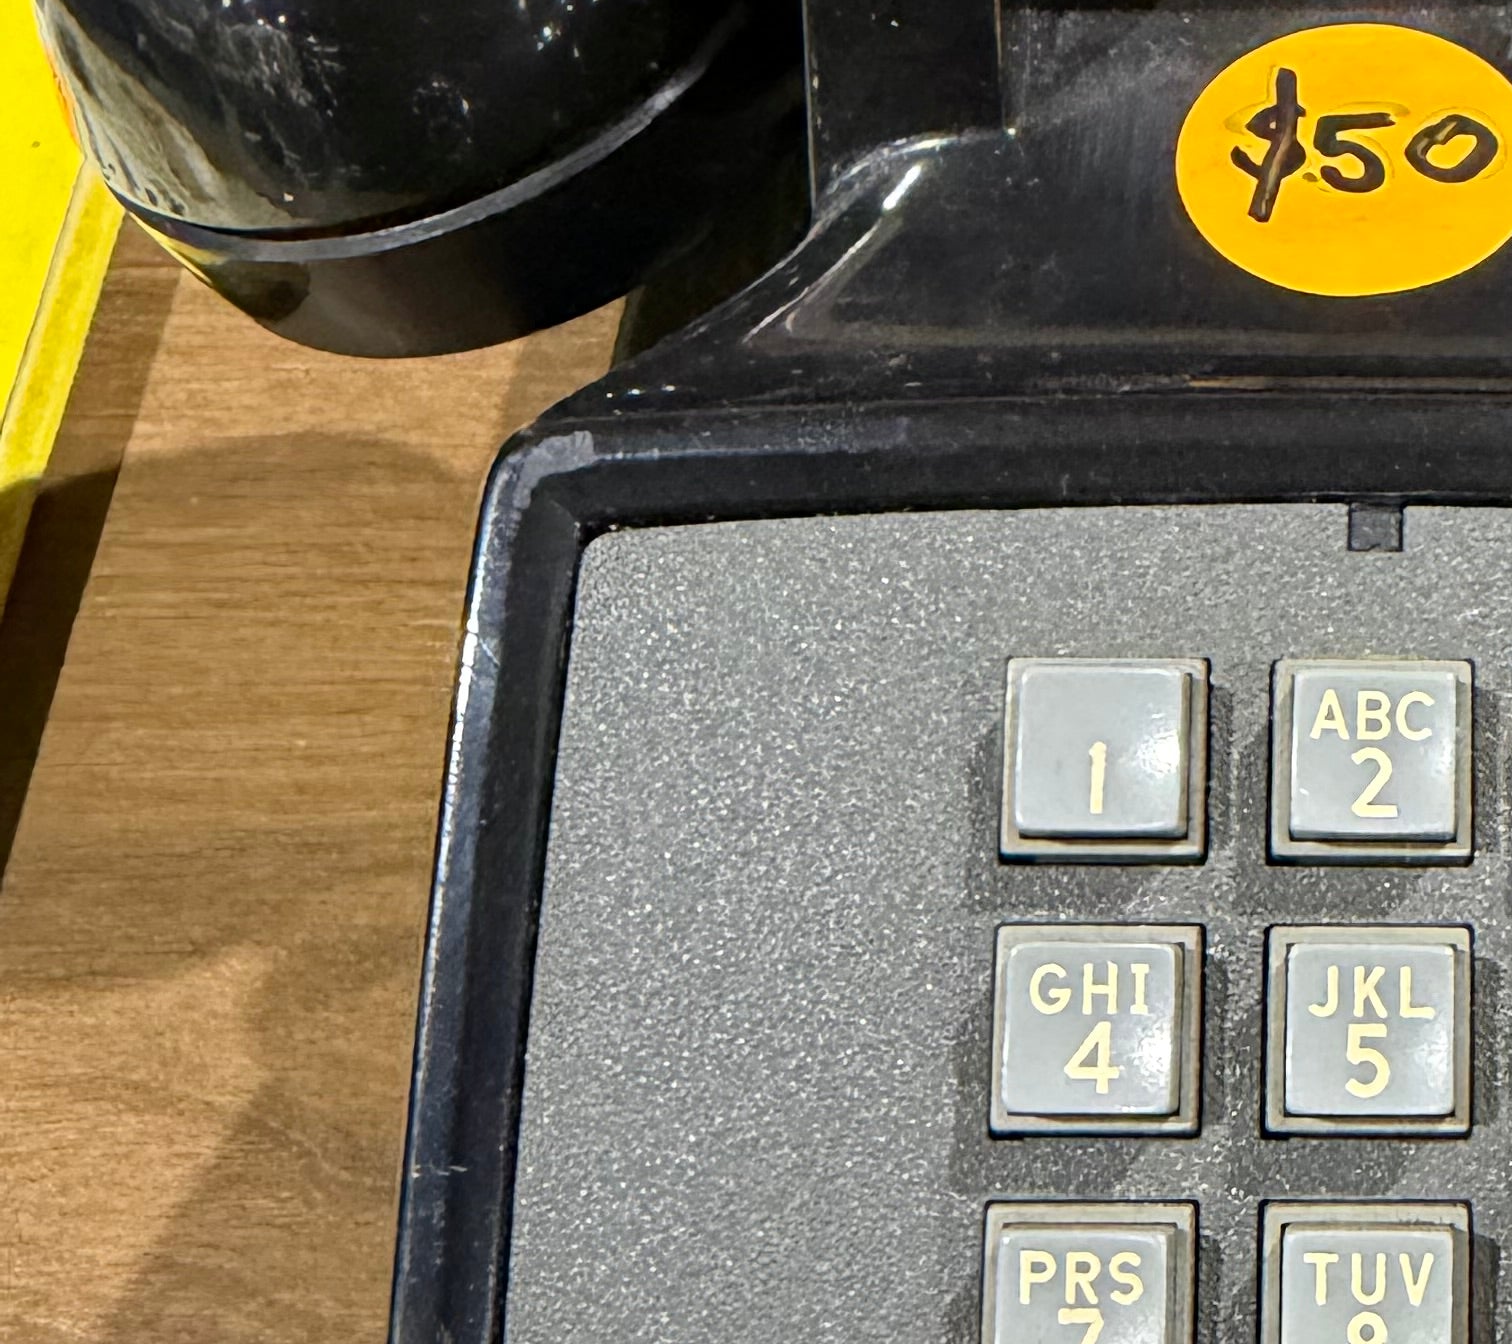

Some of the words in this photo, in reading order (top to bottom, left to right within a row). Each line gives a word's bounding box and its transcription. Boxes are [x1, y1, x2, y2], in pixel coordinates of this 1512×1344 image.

[1230, 67, 1499, 223] $50
[1309, 688, 1435, 741] ABC
[1088, 741, 1106, 814] 1
[1350, 747, 1399, 819] 2
[1028, 961, 1152, 1016] GHI
[1307, 965, 1436, 1020] JKL
[1063, 1021, 1120, 1095] 4
[1344, 1023, 1391, 1099] 5
[1018, 1251, 1145, 1306] PRS
[1302, 1251, 1436, 1308] TUV
